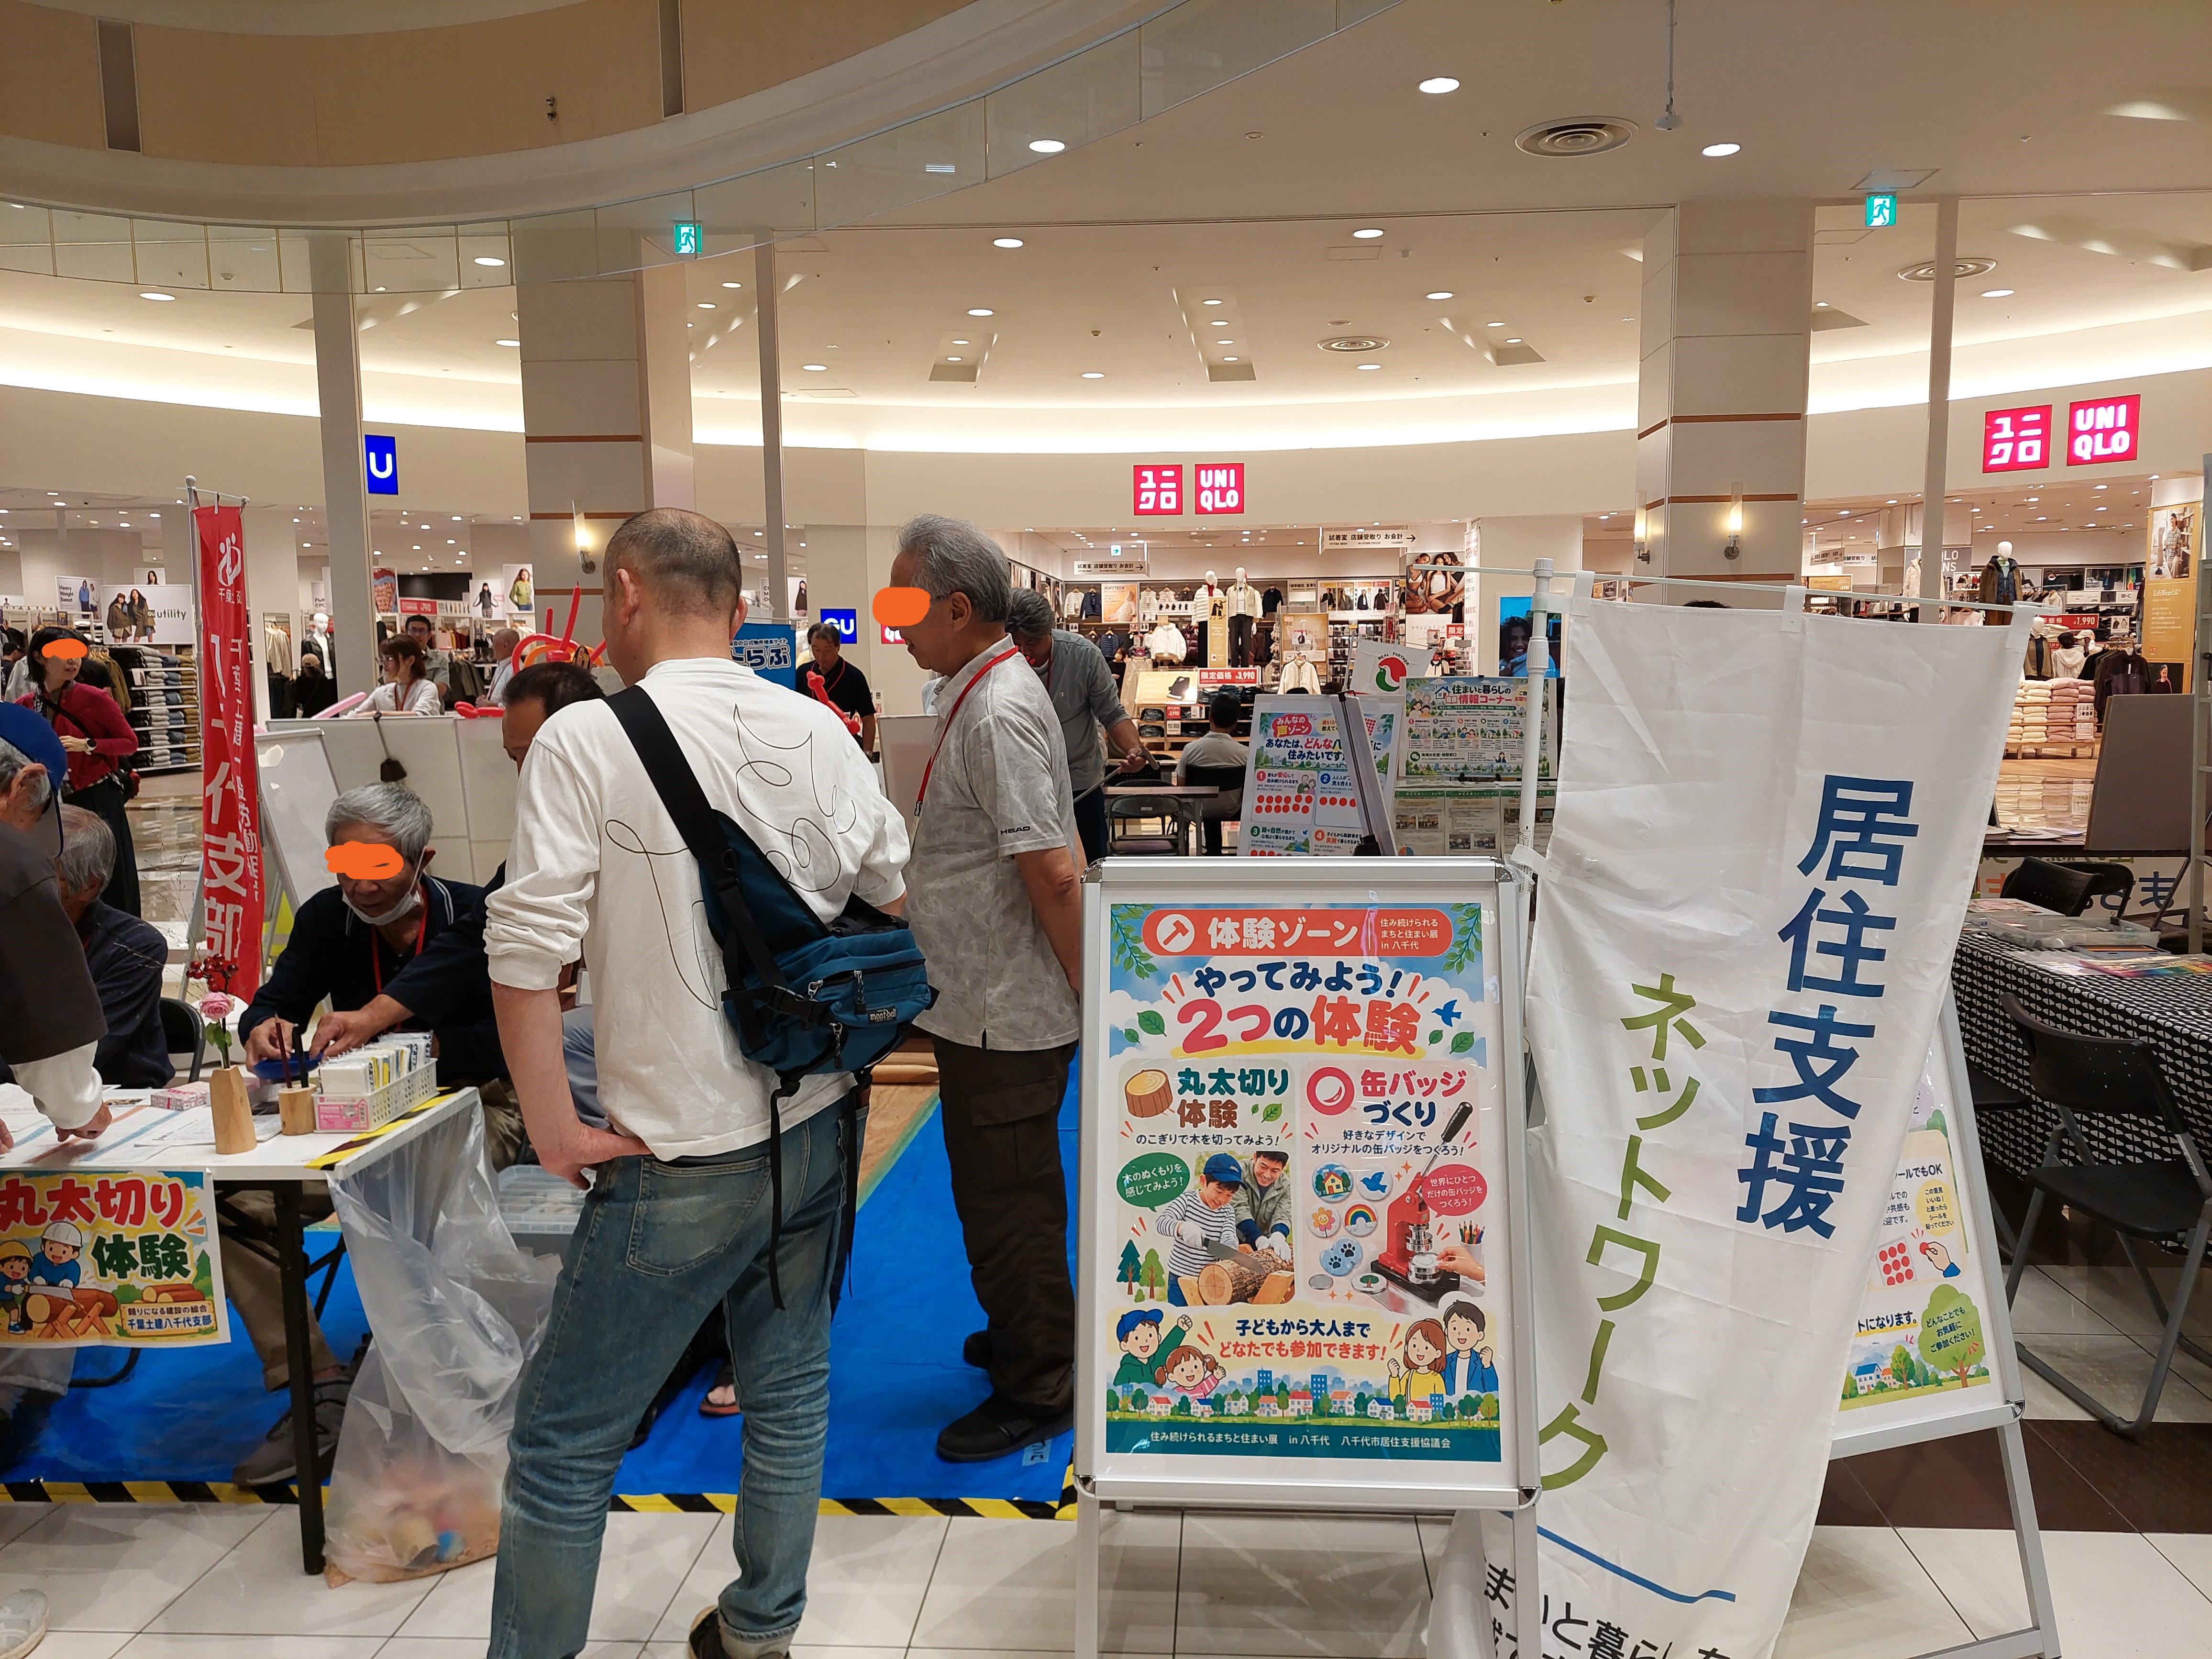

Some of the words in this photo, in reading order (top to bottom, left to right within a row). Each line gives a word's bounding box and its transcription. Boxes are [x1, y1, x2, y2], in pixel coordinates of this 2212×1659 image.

[1991, 414, 2041, 439] ユニ
[2075, 404, 2127, 431] UNI
[1990, 439, 2041, 465] クロ
[2074, 431, 2130, 460] QLO
[1140, 471, 1176, 488] ユニ
[1200, 470, 1235, 487] UNI
[1139, 491, 1176, 509] クロ
[1200, 489, 1239, 511] QLO
[156, 609, 187, 620] utility
[1452, 685, 1511, 694] 住まいと暮らしの
[1459, 695, 1512, 704] 情報コーナー
[1277, 725, 1309, 737] 声ゾーン
[1000, 826, 1031, 835] HEAD
[1208, 917, 1358, 949] 体験ゾーン
[1381, 918, 1438, 928] 住み続けられる
[1381, 929, 1438, 940] まちと住まい展
[1381, 941, 1389, 950] in
[1392, 940, 1419, 950] 八千代
[1194, 961, 1401, 996] やってみよう！
[1736, 775, 1918, 1239] 居住支援
[1176, 995, 1421, 1055] 2つの体験
[1178, 1067, 1289, 1096] 丸太切り
[1361, 1069, 1467, 1097] 缶バッジ
[1177, 1100, 1238, 1129] 体験
[1363, 1101, 1435, 1127] づくり
[1136, 1133, 1280, 1146] のこぎりで木を切ってみよう！
[1343, 1130, 1426, 1141] 好きなデザインで
[1311, 1143, 1464, 1156] オリジナルの缶バッジをつくろう！
[1123, 1163, 1182, 1182] 木のぬくもりを
[1430, 1176, 1476, 1187] 世界にひとつ
[1125, 1176, 1184, 1198] 感じてみよう！
[1427, 1185, 1483, 1198] だけの缶バッジを
[0, 1178, 183, 1231] 丸太切り
[1439, 1199, 1472, 1208] つくろう！
[1926, 1204, 1947, 1212] と思ったら
[1541, 972, 1706, 1491] ネットワーク
[1925, 1220, 1954, 1229] 貼ってください
[91, 1234, 190, 1279] 体験
[1926, 1307, 1965, 1328] どんなことでも
[1236, 1319, 1371, 1338] 子どもから大人まで
[1936, 1321, 1962, 1337] お気軽に
[1931, 1328, 1975, 1353] ご参加ください！
[1219, 1340, 1386, 1361] どなたでも参加できます！
[1150, 1431, 1278, 1446] 住み続けられるまちと住まい展
[1289, 1436, 1297, 1446] in
[1300, 1436, 1330, 1447] 八千代
[1341, 1436, 1451, 1449] 八千代市居住支援協議会
